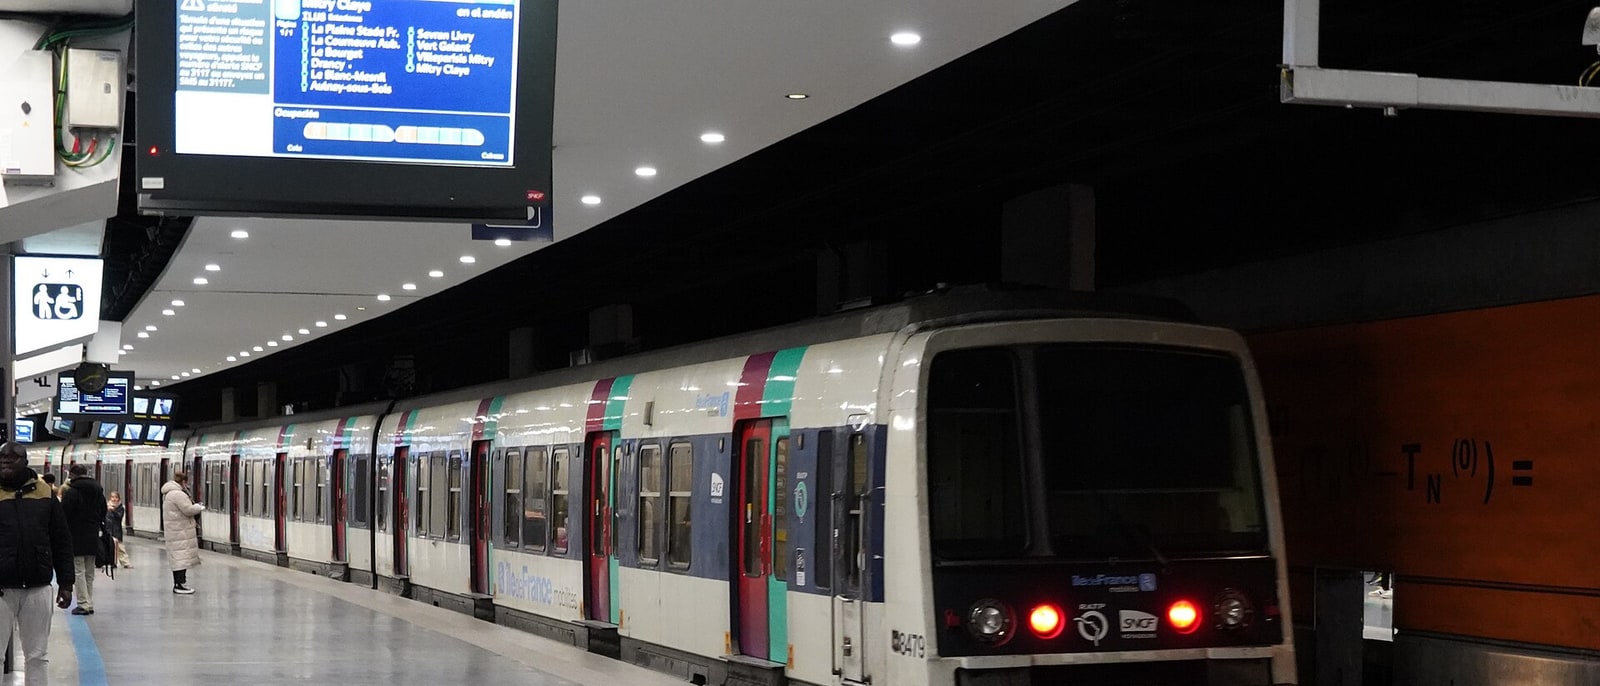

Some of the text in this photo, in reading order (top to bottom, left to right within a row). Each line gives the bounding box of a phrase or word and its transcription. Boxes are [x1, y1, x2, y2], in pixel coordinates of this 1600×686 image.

[456, 8, 470, 17] en
[471, 7, 481, 18] el
[311, 23, 400, 38] La Plaine Stade Fr.
[417, 28, 475, 44] Sevran Livry
[324, 35, 377, 48] Courneuve
[377, 37, 401, 49] Aub.
[416, 40, 471, 53] Vert Galant
[324, 46, 363, 60] Bourget
[311, 57, 345, 71] Drancy
[468, 54, 495, 68] Mitry
[191, 68, 210, 78] 3117
[416, 63, 470, 77] Mitry Claye
[209, 79, 236, 88] 31177.
[1122, 617, 1156, 629] SNCF
[900, 632, 926, 659] 8479
